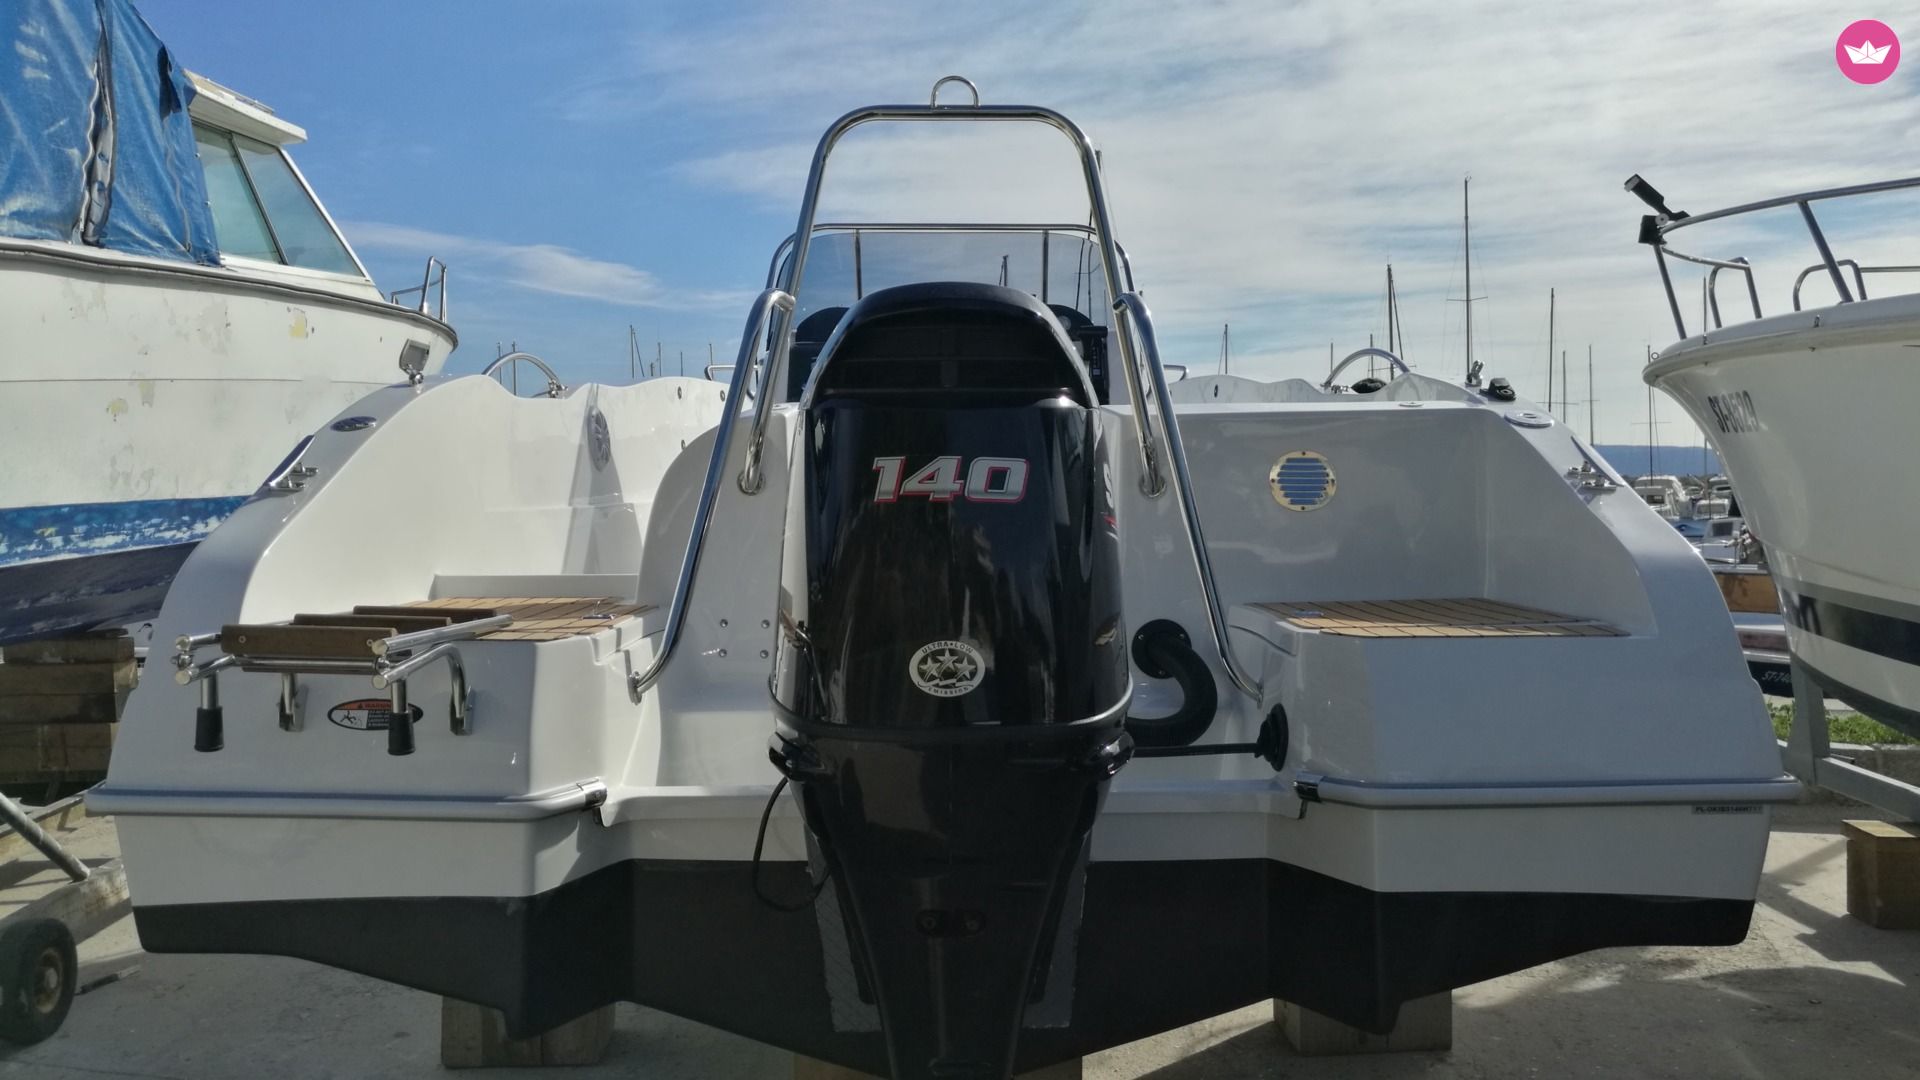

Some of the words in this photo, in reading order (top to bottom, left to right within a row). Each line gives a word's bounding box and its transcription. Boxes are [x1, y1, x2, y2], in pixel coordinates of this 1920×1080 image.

[1707, 389, 1759, 433] ST-8529
[872, 455, 1030, 503] 140
[921, 641, 949, 655] ULTRA
[954, 642, 974, 654] LOW
